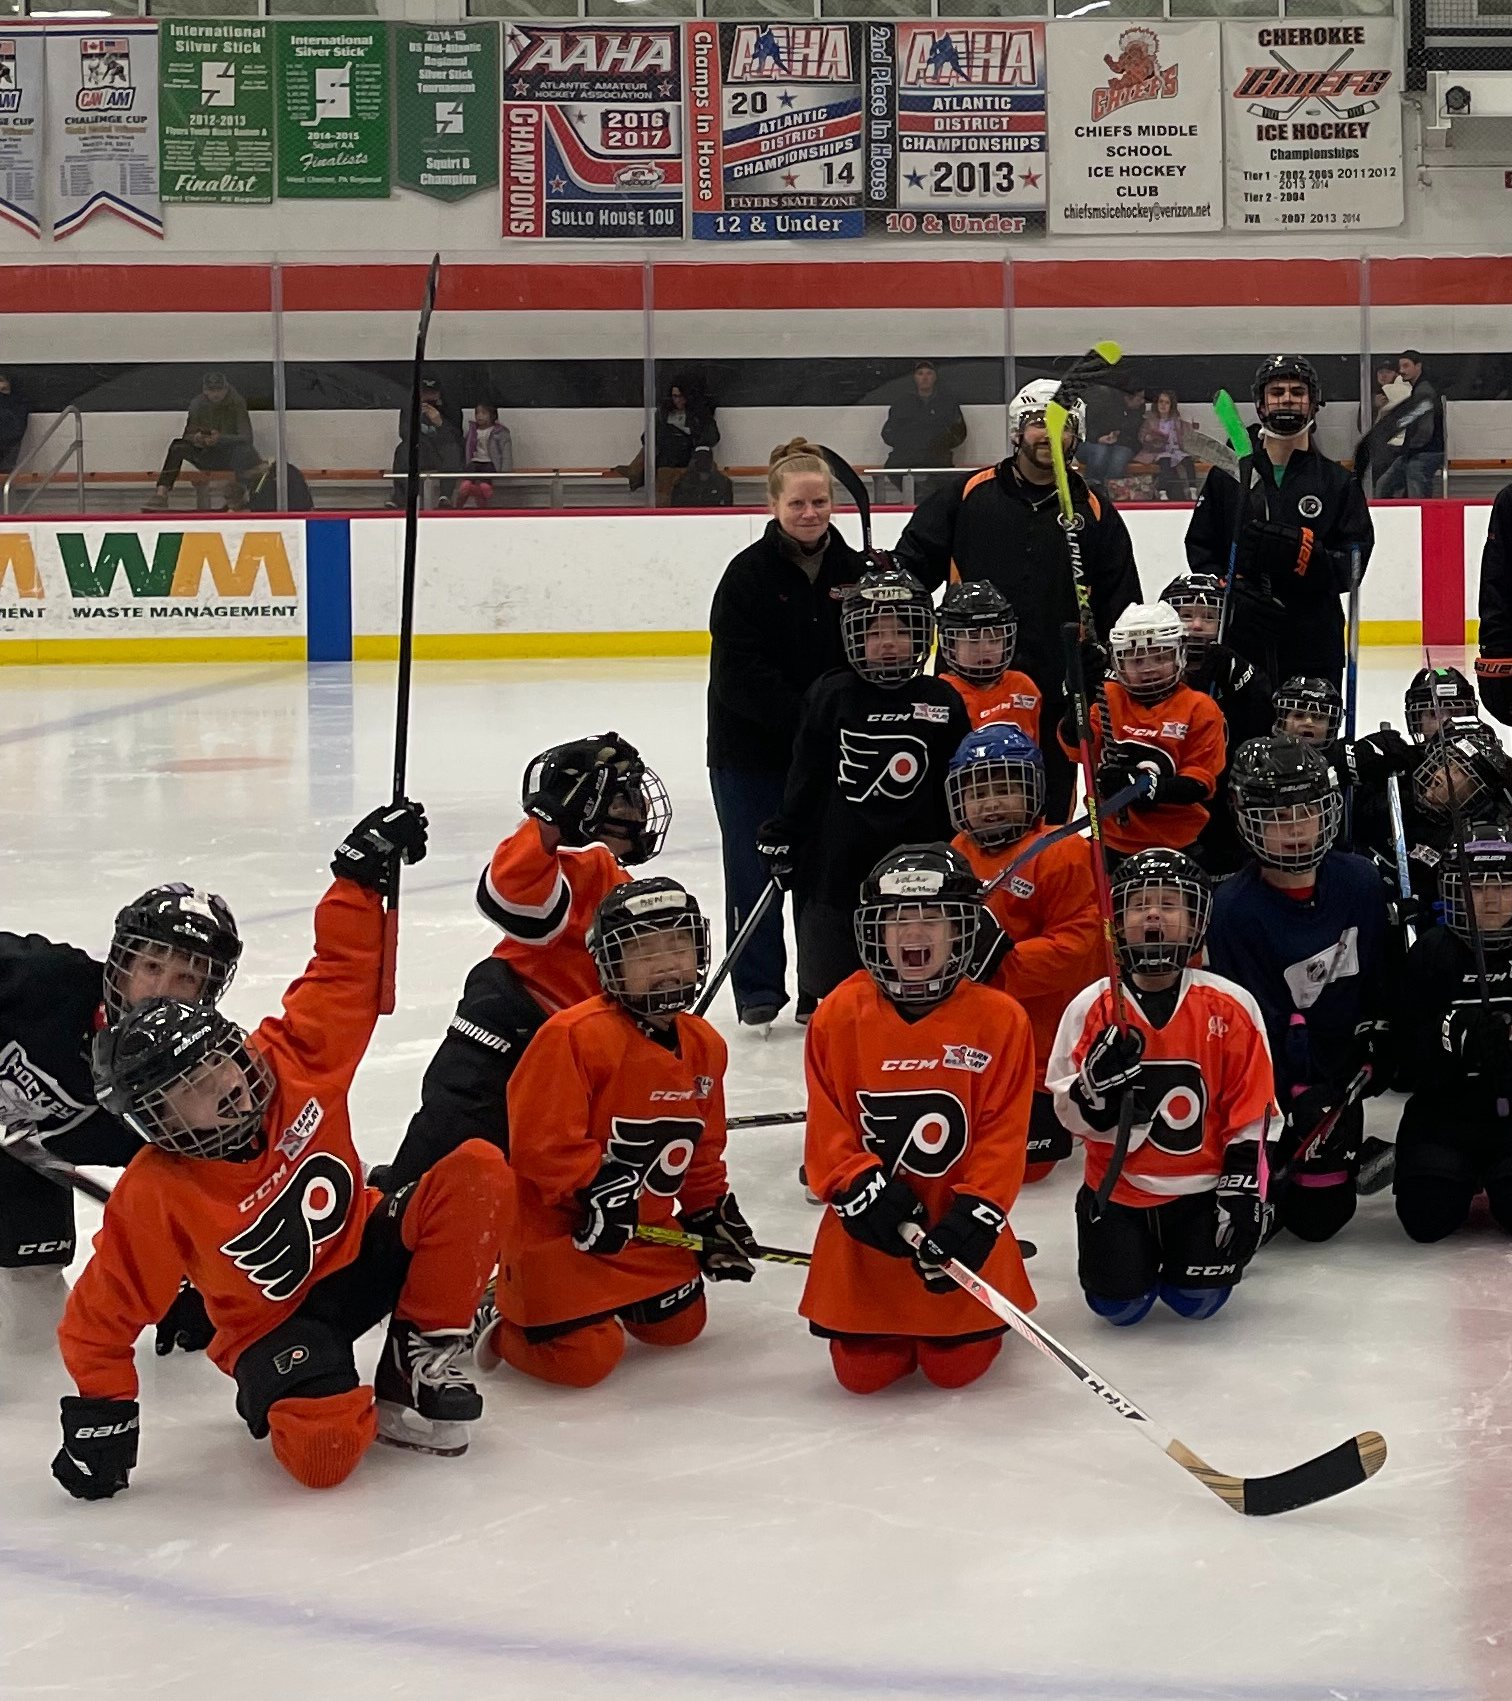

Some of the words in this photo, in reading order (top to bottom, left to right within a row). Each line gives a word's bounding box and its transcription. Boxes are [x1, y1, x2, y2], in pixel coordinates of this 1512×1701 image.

[170, 24, 266, 38] International
[1258, 26, 1366, 47] CHEROKEE
[175, 40, 218, 53] Silver
[223, 41, 261, 53] Stick
[290, 35, 374, 46] International
[870, 27, 891, 64] 2nd
[295, 46, 331, 57] Silver
[333, 47, 365, 57] Stick
[518, 33, 673, 73] AAHA
[691, 31, 713, 107] Champs
[539, 81, 590, 90] ATLANTIC
[594, 82, 648, 91] AMATEUR
[870, 66, 891, 116] Place
[535, 91, 576, 99] HOCKEY
[580, 91, 652, 100] ASSOCIATION
[730, 91, 768, 115] 20
[932, 97, 1012, 111] ATLANTIC
[65, 115, 122, 126] CHALLENGE
[126, 115, 148, 125] CUP
[190, 114, 246, 126] 2012-2013
[607, 112, 664, 128] 2016
[696, 113, 714, 133] In
[758, 108, 828, 135] ATLANTIC
[934, 117, 1010, 131] DISTRICT
[307, 132, 360, 140] 2014-2015
[871, 120, 892, 140] In
[1074, 126, 1133, 137] CHIEFS
[1137, 125, 1199, 137] MIDDLE
[1256, 123, 1289, 141] ICE
[1292, 122, 1371, 140] HOCKEY
[340, 141, 355, 149] AA
[607, 131, 664, 147] 2017
[760, 126, 827, 152] DISTRICT
[902, 137, 1041, 151] CHAMPIONSHIPS
[733, 138, 854, 178] CHAMPIONSHIPS
[1106, 146, 1173, 157] SCHOOL
[1270, 148, 1360, 161] Championships
[299, 152, 369, 171] Finalists
[426, 157, 460, 170] Squirt
[509, 107, 539, 235] CHAMPIONS
[696, 141, 715, 201] House
[822, 162, 855, 185] 14
[871, 143, 892, 201] House
[931, 161, 1015, 195] 2013
[1088, 166, 1115, 177] ICE
[1119, 165, 1187, 177] HOCKEY
[1243, 171, 1265, 181] Tier
[175, 174, 257, 192] Finalist
[420, 173, 477, 186] Champion
[1279, 179, 1306, 190] 2013
[1311, 180, 1329, 190] 2014
[1116, 186, 1159, 197] CLUB
[1243, 192, 1264, 202] Tier
[1266, 192, 1273, 202] 2
[1280, 192, 1305, 202] 2004
[730, 197, 778, 208] FLYERS
[782, 197, 819, 208] SKATE
[821, 196, 856, 207] ZONE
[649, 209, 675, 226] 10U
[715, 216, 742, 233] 12
[750, 215, 767, 233] &
[776, 214, 843, 232] Under
[886, 213, 917, 233] 10
[922, 213, 943, 233] &
[949, 213, 1026, 234] Under
[1281, 214, 1306, 224] 2007
[1310, 214, 1337, 224] 2013
[1342, 214, 1361, 224] 2014
[56, 532, 297, 598] WM
[72, 607, 144, 619] WASTE
[150, 605, 298, 618] MANAGEMENT
[867, 713, 911, 722] CCM
[881, 1058, 940, 1072] CCM
[650, 1089, 694, 1101] CCM
[294, 1099, 315, 1133] LEARN
[304, 1108, 321, 1134] PLAY
[238, 1162, 288, 1213] CCM
[18, 1238, 73, 1256] CCM
[1186, 1263, 1236, 1276] CCM
[1083, 1376, 1138, 1418] CCM
